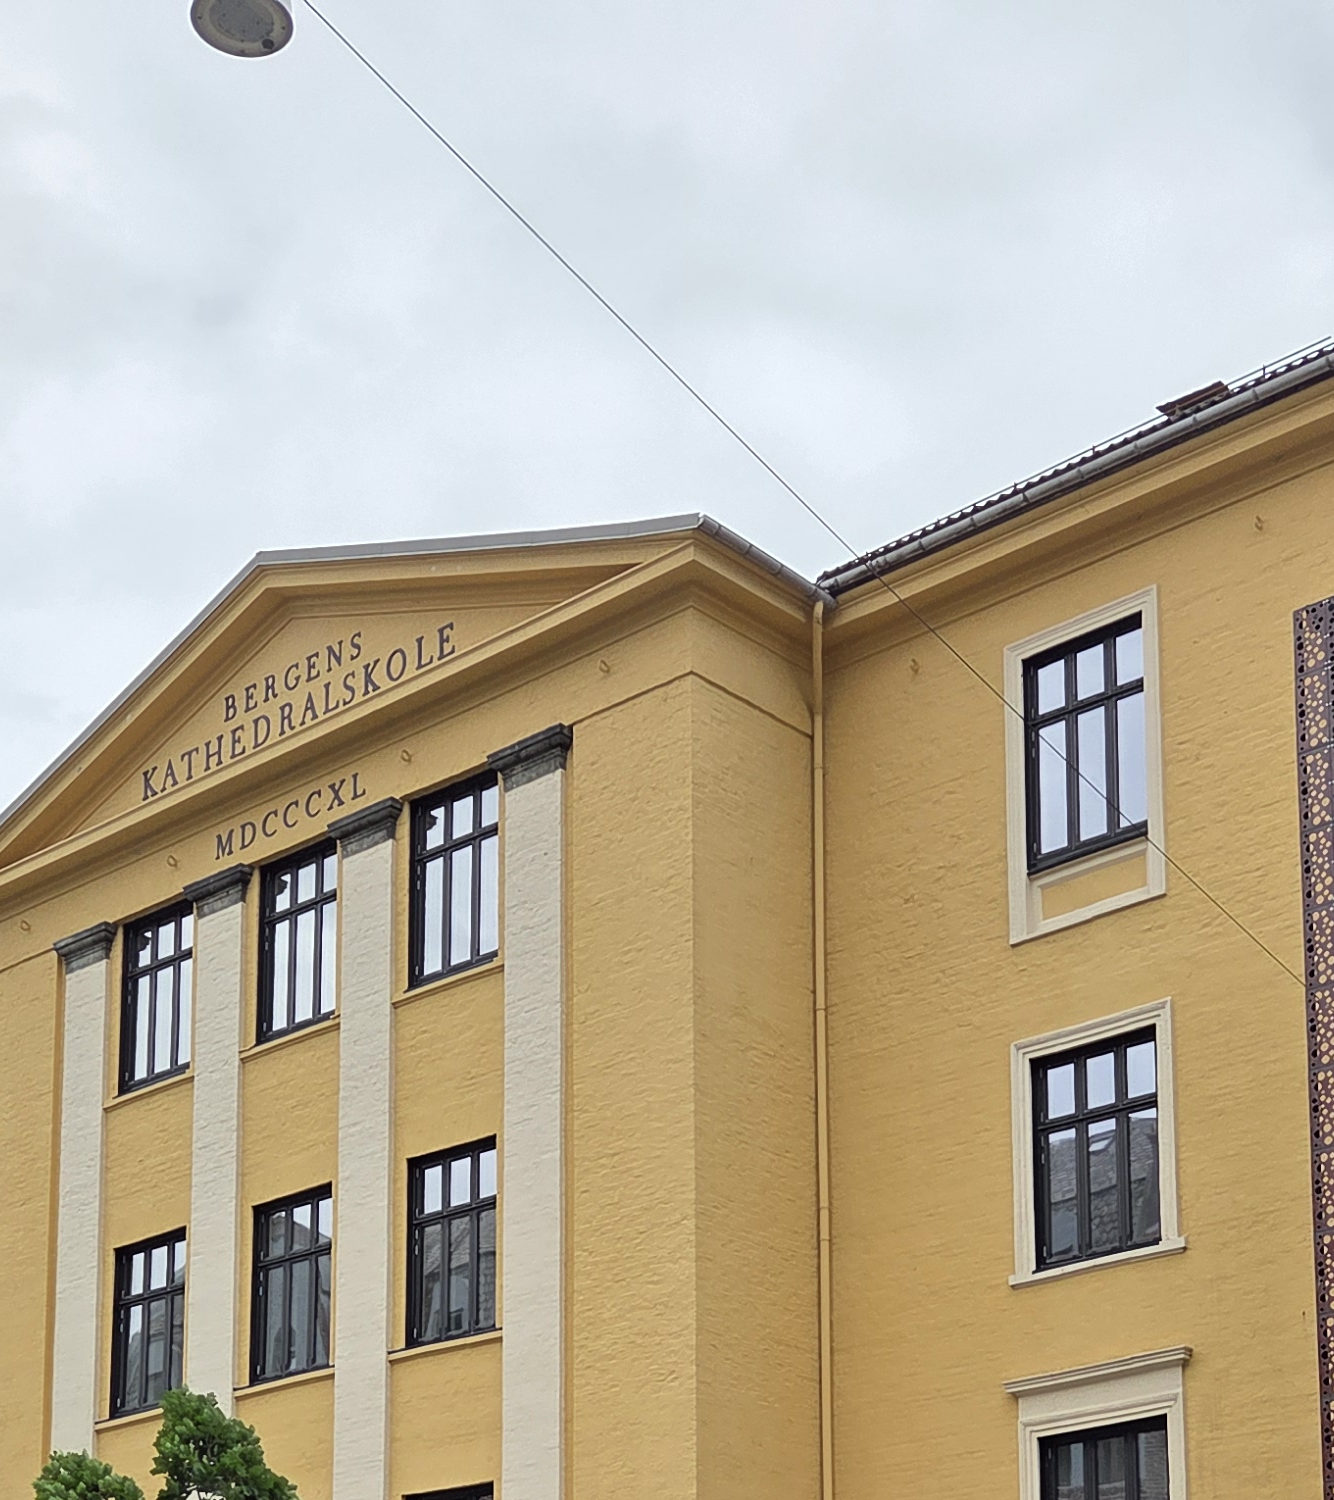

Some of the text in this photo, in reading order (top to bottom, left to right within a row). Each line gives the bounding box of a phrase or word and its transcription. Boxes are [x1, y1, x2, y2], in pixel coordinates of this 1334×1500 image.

[140, 621, 457, 802] KATHEDRALSKOLE
[223, 631, 363, 723] BERGENS
[214, 771, 368, 861] MDCCCXL
